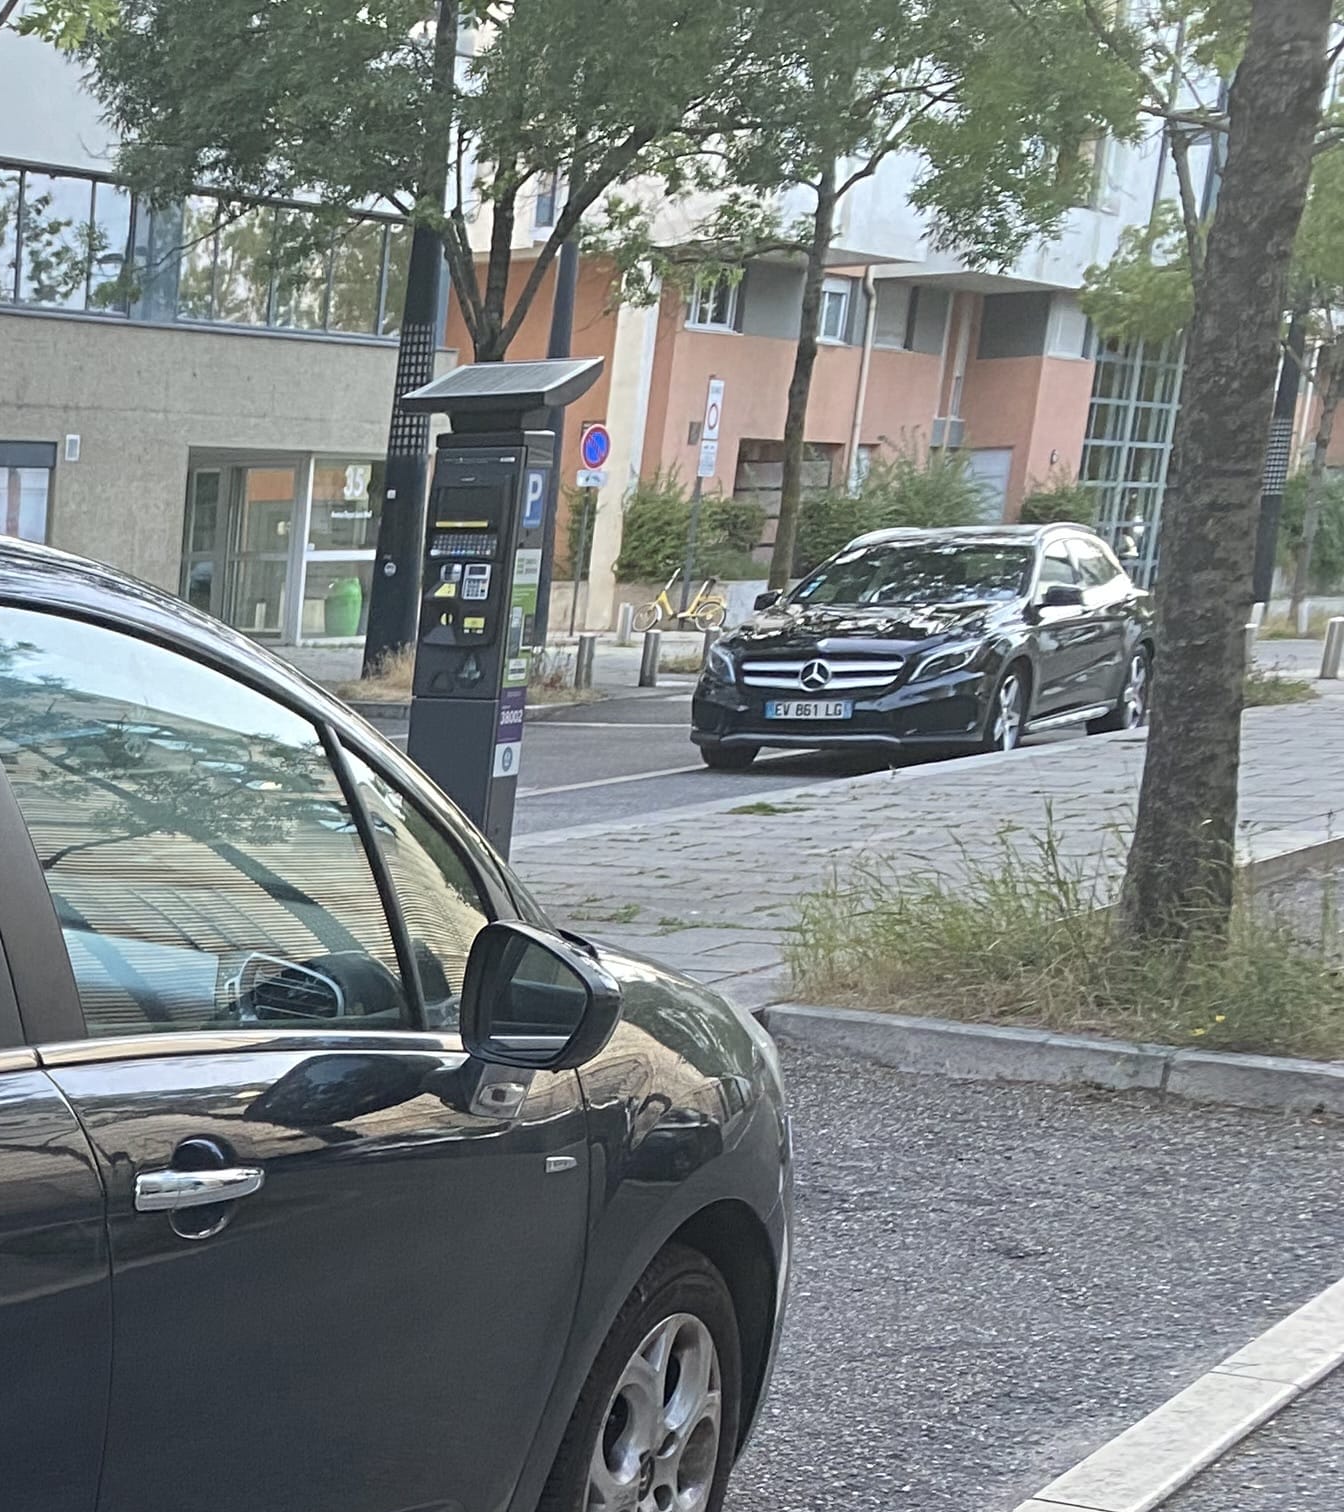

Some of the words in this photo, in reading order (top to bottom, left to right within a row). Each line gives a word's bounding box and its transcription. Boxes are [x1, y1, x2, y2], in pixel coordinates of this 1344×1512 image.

[525, 473, 543, 518] P
[775, 703, 791, 717] EV
[795, 703, 818, 717] 861
[825, 703, 843, 717] LG
